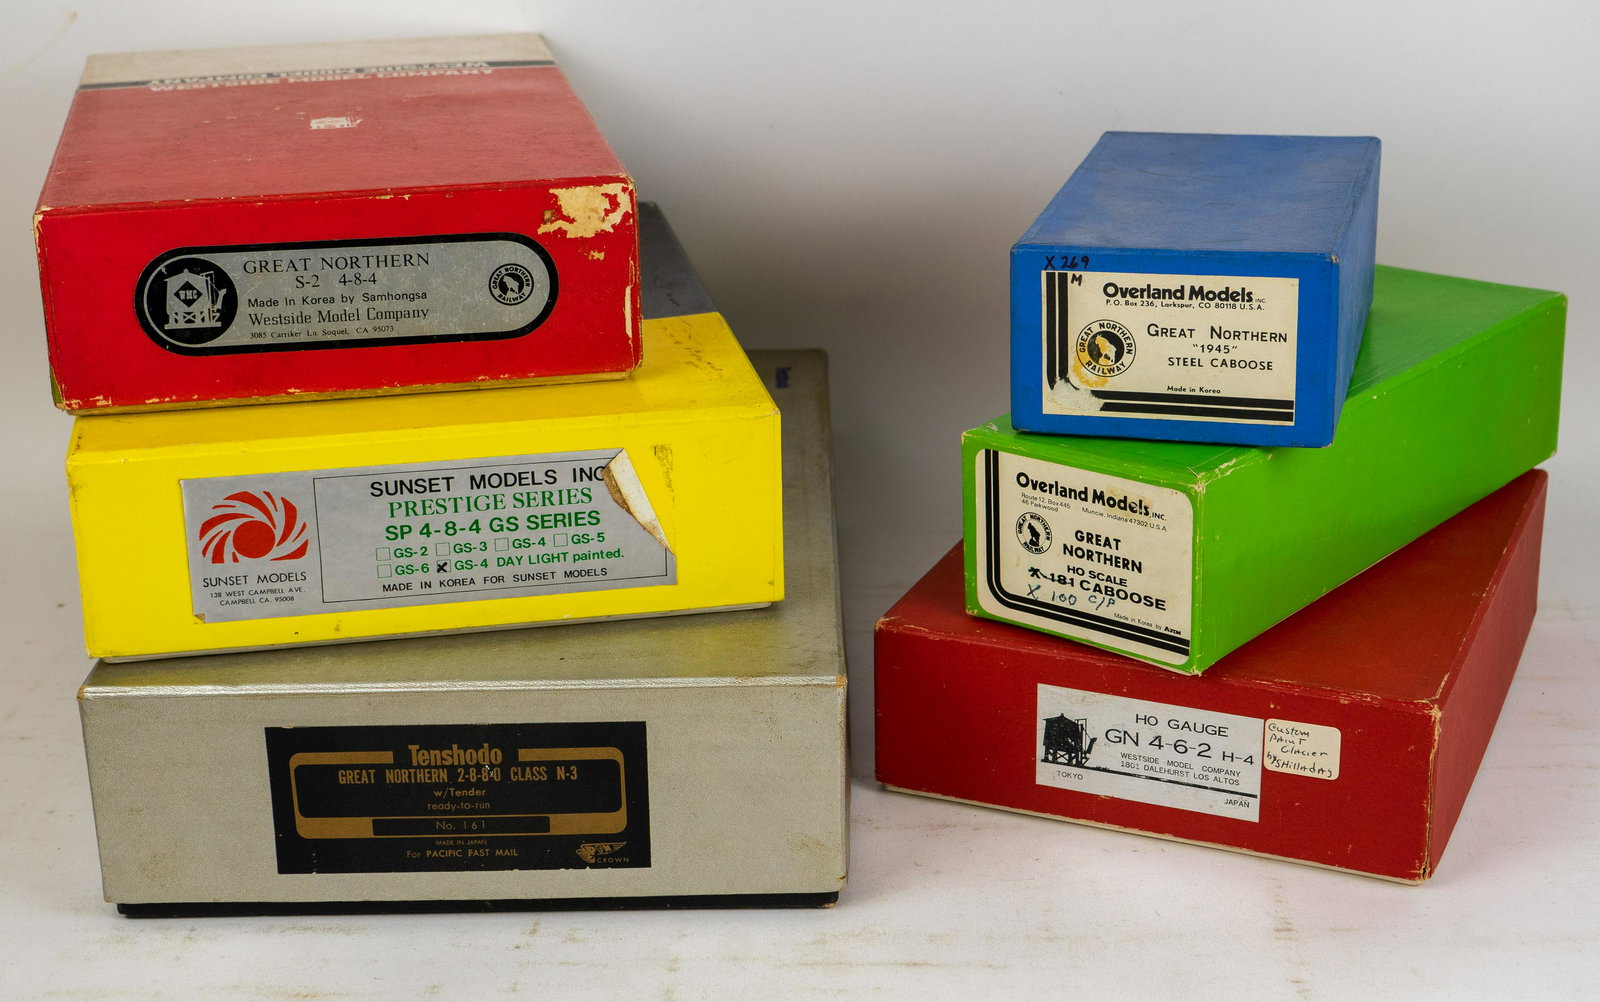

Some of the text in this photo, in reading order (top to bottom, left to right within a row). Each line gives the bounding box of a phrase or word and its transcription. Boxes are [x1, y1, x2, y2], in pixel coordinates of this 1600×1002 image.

[150, 62, 489, 86] WESTSIDE MODEL COMPANY
[151, 69, 493, 92] WESTSIDE MODEL COMPANY
[243, 253, 430, 274] GREAT NORTHERN
[1044, 256, 1090, 270] X 269
[296, 272, 378, 289] S-2 4-8-4
[492, 266, 530, 289] GREAT NORTHERN
[1070, 273, 1082, 286] M
[498, 292, 526, 302] RAILWAY
[1103, 282, 1185, 300] Overland
[248, 292, 427, 308] Made In Korea by Samhongsa
[1214, 302, 1237, 310] 80118
[248, 307, 430, 326] Westside Model Company
[250, 332, 266, 340] 3085
[270, 330, 302, 338] Carriker
[356, 327, 368, 335] CA
[372, 325, 394, 333] 95073
[1079, 322, 1133, 354] GREAT NORTHERN
[1086, 360, 1126, 374] RAILWAY
[1168, 357, 1273, 370] STEEL CABOOSE
[1200, 386, 1220, 394] Korea
[370, 476, 455, 497] SUNSET
[470, 469, 558, 490] MODELS
[1016, 472, 1088, 502] Overland
[388, 487, 593, 518] PRESTIGE SERIES
[1022, 492, 1038, 501] Route
[1048, 498, 1059, 506] Box
[1030, 500, 1058, 512] Parkwood
[384, 510, 600, 541] SP 4-8-4 GS SERIES
[1018, 514, 1050, 540] GREAT NORTHERN
[1107, 512, 1128, 522] Indiana
[1129, 518, 1148, 528] 47302
[1023, 542, 1044, 552] RAILWAY
[1074, 530, 1121, 550] GREAT
[454, 548, 624, 570] GS-4 DAY LIGHT painted.
[1062, 544, 1142, 574] NORTHERN
[394, 562, 430, 576] GS-6
[1067, 564, 1128, 587] HO SCALE
[202, 572, 307, 588] SUNSET MODELS
[382, 568, 608, 593] MADE IN KOREA FOR SUNSET MODELS
[248, 588, 284, 596] CAMPBELL
[1026, 584, 1041, 600] X
[1052, 590, 1077, 606] 100
[1080, 579, 1166, 611] CABOOSE
[220, 598, 256, 606] CAMPBELL
[1114, 612, 1129, 622] Made
[1138, 618, 1153, 628] Korea
[1136, 714, 1229, 738] HO GAUGE
[408, 743, 502, 766] Tenshodo
[1104, 728, 1254, 765] GN 4-6-2 H-4
[1120, 752, 1241, 778] WESTSIDE MODEL COMPANY
[1120, 761, 1240, 786] 1801 DALEHURST LOS ALTOS
[338, 766, 578, 784] GREAT NORTHERN 2-8-8-0 CLASS N-3
[1056, 770, 1084, 781] TOKYO
[433, 788, 486, 799] w/Tender
[428, 802, 490, 811] ready-to-run
[1224, 798, 1250, 808] JAPAN
[436, 821, 456, 830] No.
[406, 848, 519, 858] For PACIFIC FAST MAIL
